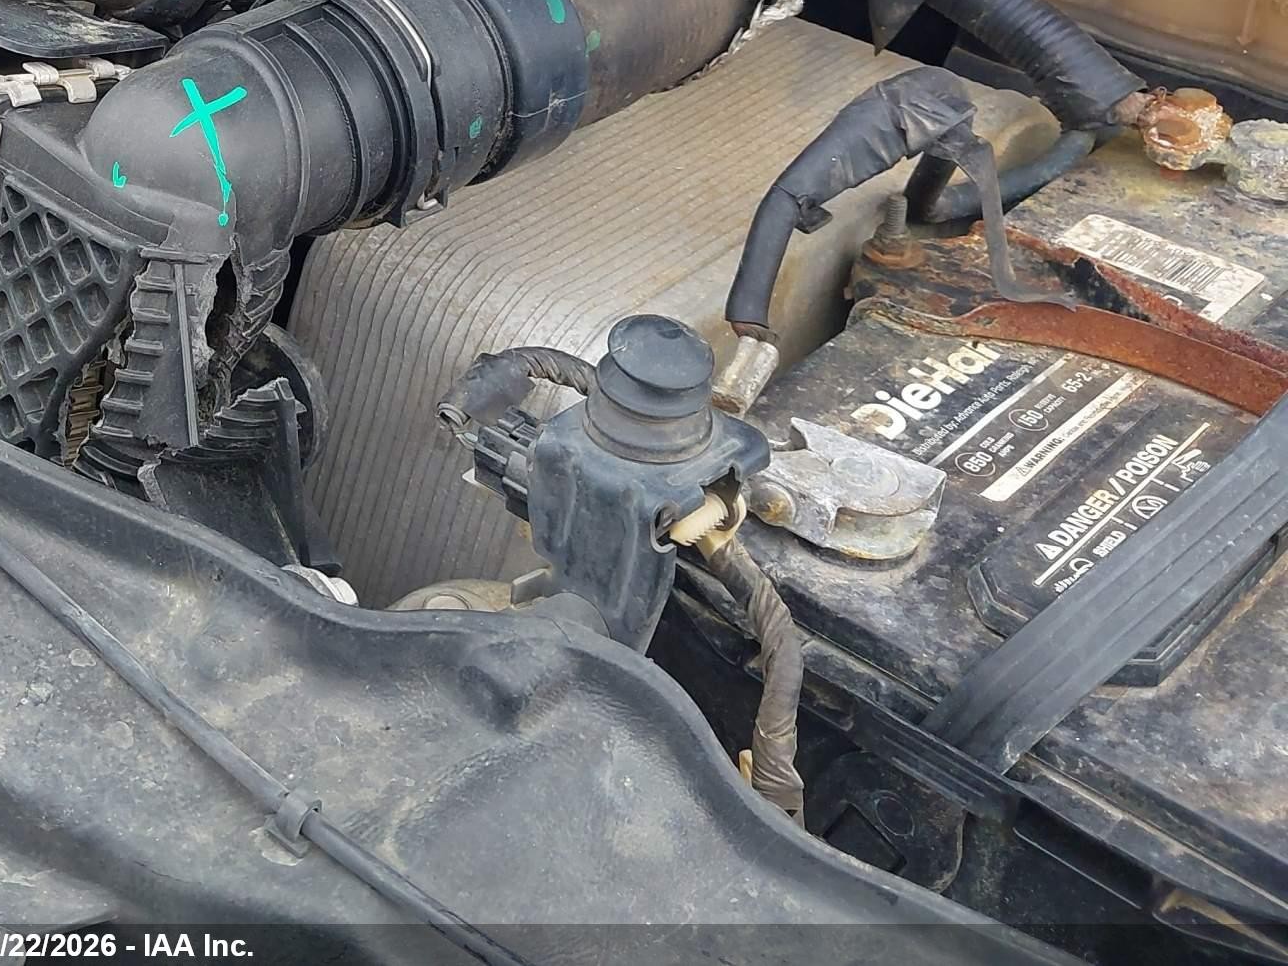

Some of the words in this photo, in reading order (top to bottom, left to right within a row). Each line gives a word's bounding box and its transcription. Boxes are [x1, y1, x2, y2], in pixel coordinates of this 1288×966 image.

[851, 340, 1002, 441] DieHar
[1061, 371, 1093, 393] 65-2
[955, 400, 982, 424] Advance
[977, 390, 996, 405] Auto
[1018, 409, 1044, 427] 150
[963, 451, 993, 473] 850
[1026, 435, 1065, 469] WARNING:
[1048, 488, 1120, 548] DANGER
[1116, 434, 1180, 485] POISON
[1092, 530, 1128, 559] SHIELD
